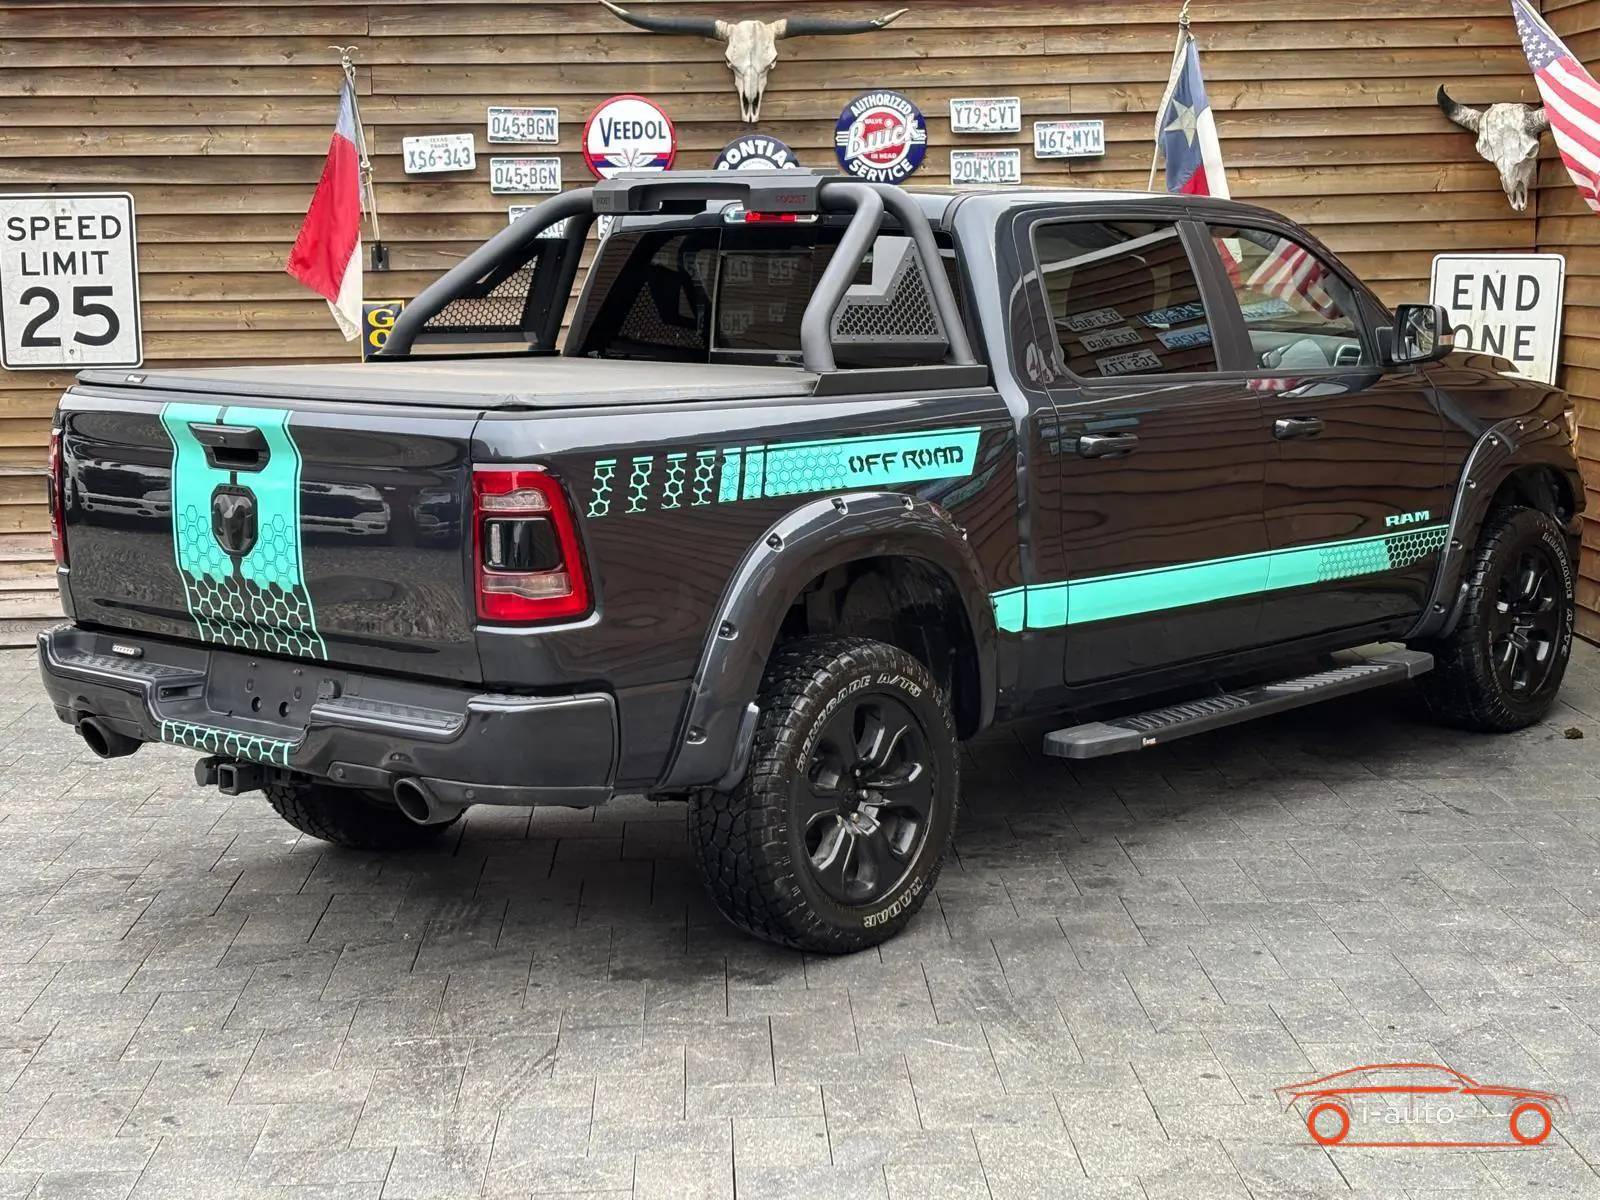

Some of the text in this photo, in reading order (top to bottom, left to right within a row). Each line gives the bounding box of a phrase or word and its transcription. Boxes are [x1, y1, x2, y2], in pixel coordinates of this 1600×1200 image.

[851, 94, 912, 117] AUTHORIZED
[844, 112, 920, 160] Buick
[849, 158, 913, 182] SERVICE
[7, 215, 122, 241] SPEED
[21, 251, 109, 276] LIMIT
[1452, 274, 1540, 311] END
[19, 286, 120, 348] 25
[1453, 324, 1536, 361] ONE
[848, 445, 963, 475] OFF ROAD
[1385, 510, 1430, 527] RAM
[863, 876, 924, 928] RADAR
